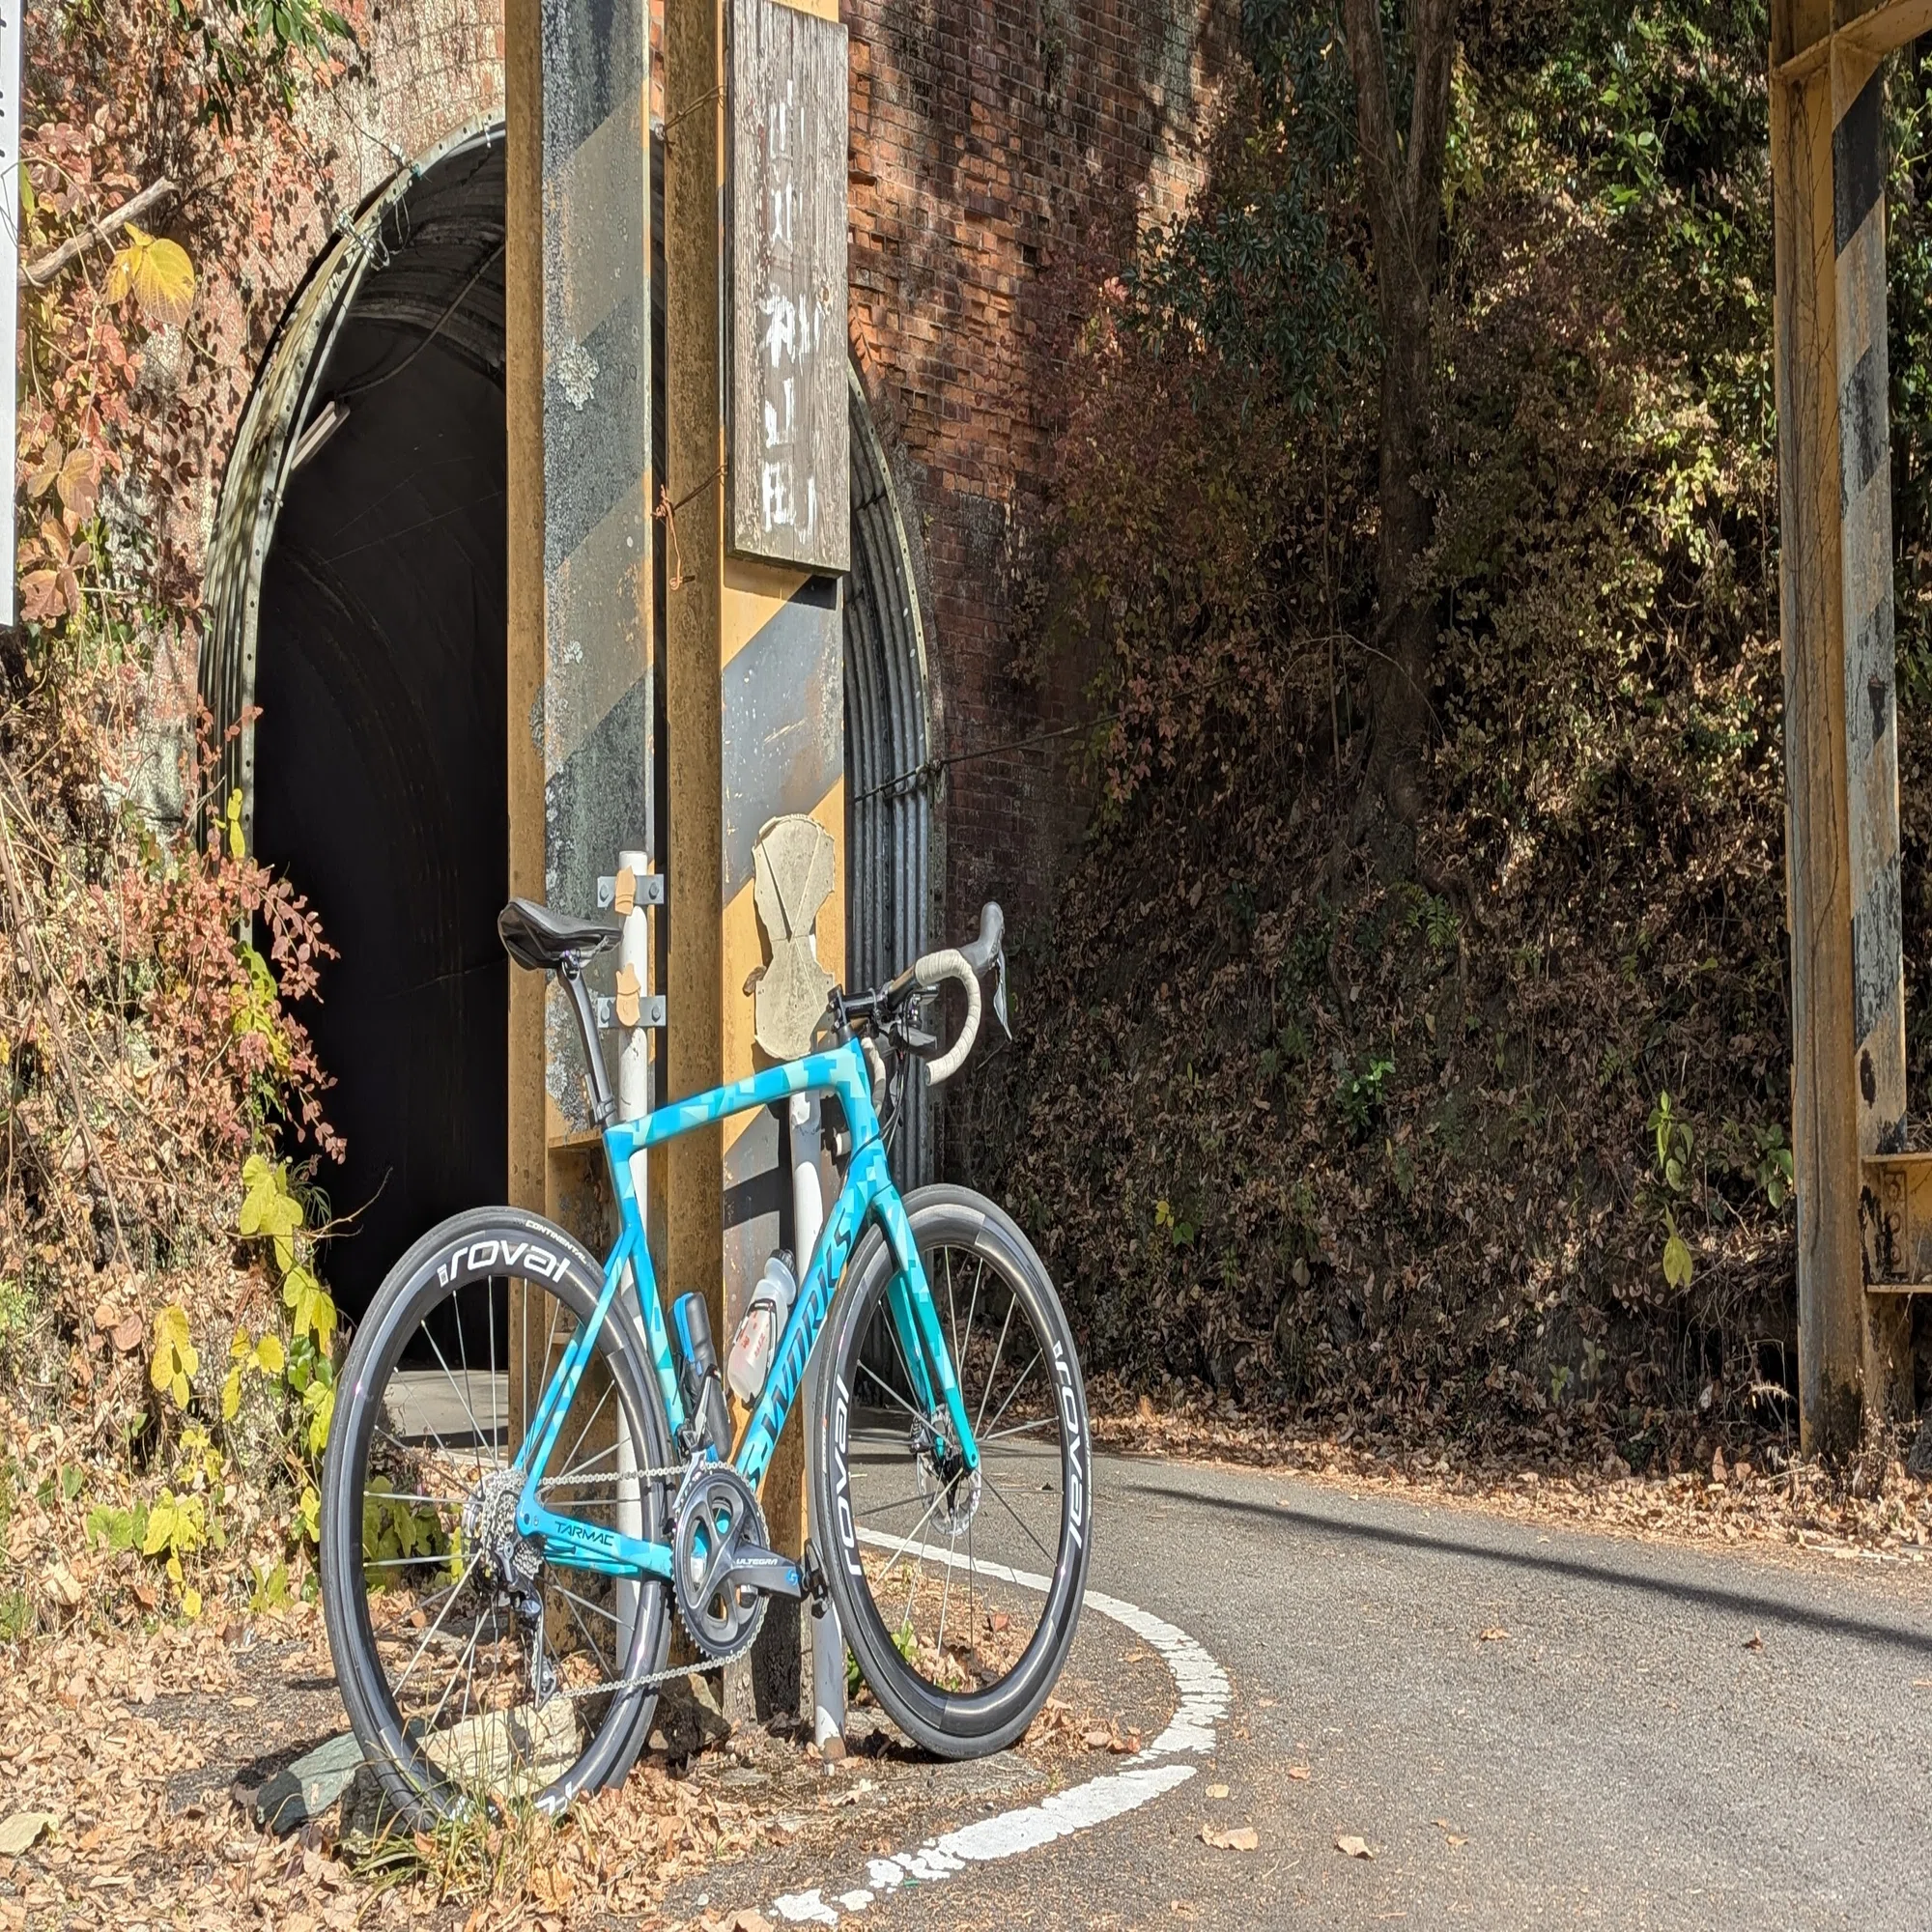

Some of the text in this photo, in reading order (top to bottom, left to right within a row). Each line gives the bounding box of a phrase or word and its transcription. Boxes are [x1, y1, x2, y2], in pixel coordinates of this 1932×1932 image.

[450, 1240, 571, 1283] roval
[525, 1219, 587, 1264] CONTINENTAL
[835, 1374, 863, 1576] roval
[1055, 1361, 1083, 1549] roval
[554, 1520, 614, 1547] TARMAC
